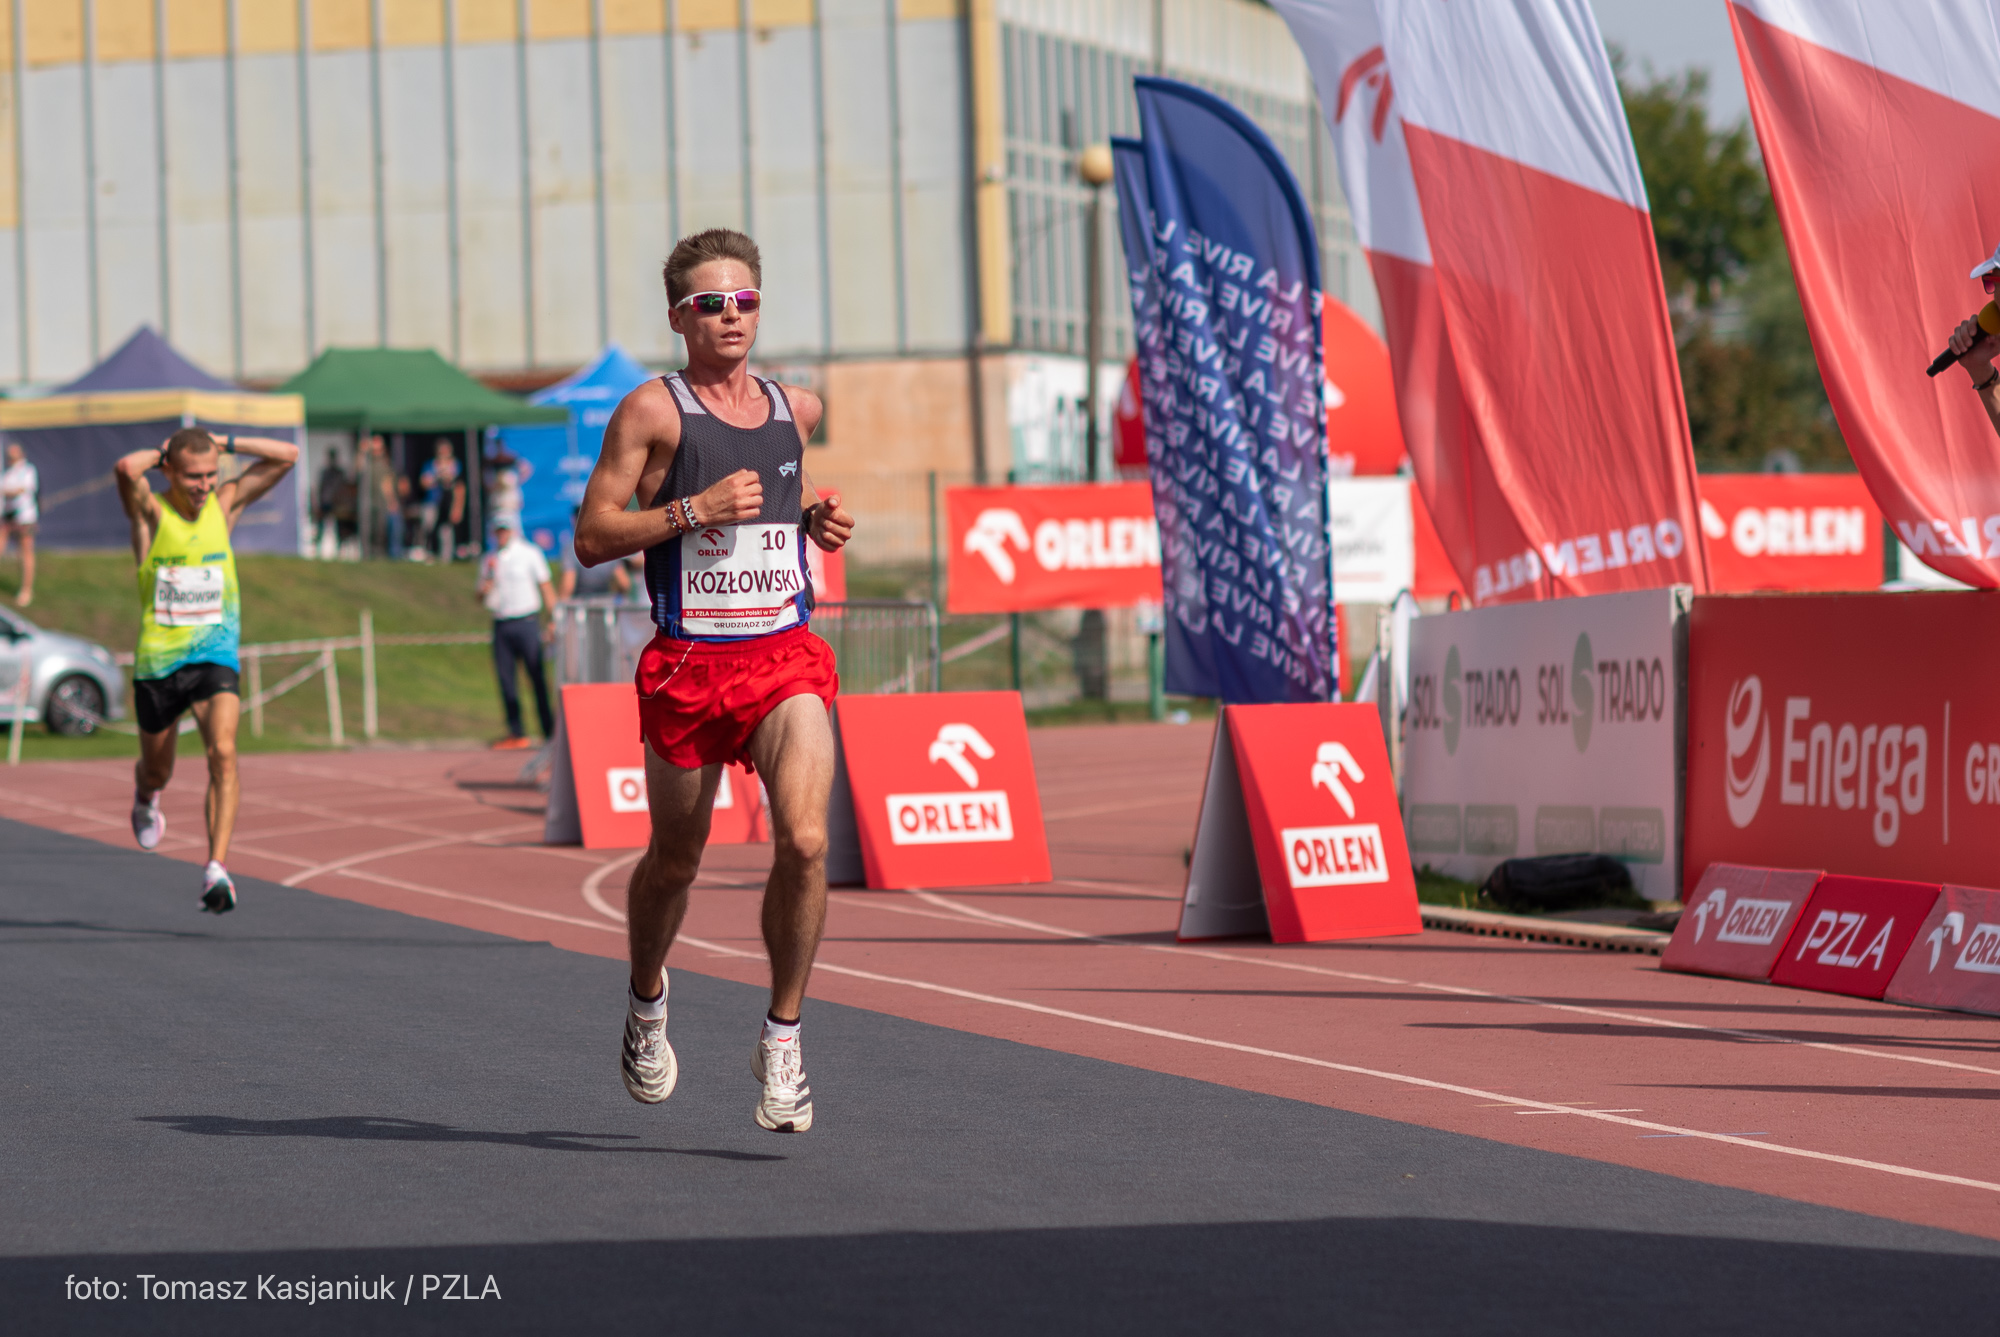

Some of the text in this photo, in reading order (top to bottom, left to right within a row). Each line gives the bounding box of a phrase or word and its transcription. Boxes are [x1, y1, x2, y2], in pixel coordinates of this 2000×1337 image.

[761, 530, 786, 551] 10
[1034, 518, 1163, 571] ORLEN
[1731, 506, 1865, 558] ORLEN
[697, 548, 729, 557] ORLEN
[203, 570, 211, 581] 3
[687, 569, 800, 595] KOZŁOWSKI
[713, 621, 760, 629] GRUDZIĄDZ
[1412, 667, 1522, 730] SOL TRADO
[1537, 656, 1665, 725] SOL TRADO
[1780, 695, 1928, 848] Energa
[899, 803, 1001, 833] ORLEN
[1294, 836, 1378, 877] ORLEN
[1725, 900, 1784, 938] ORLEN
[1796, 909, 1896, 972] PZLA
[1965, 931, 2000, 965] ORL
